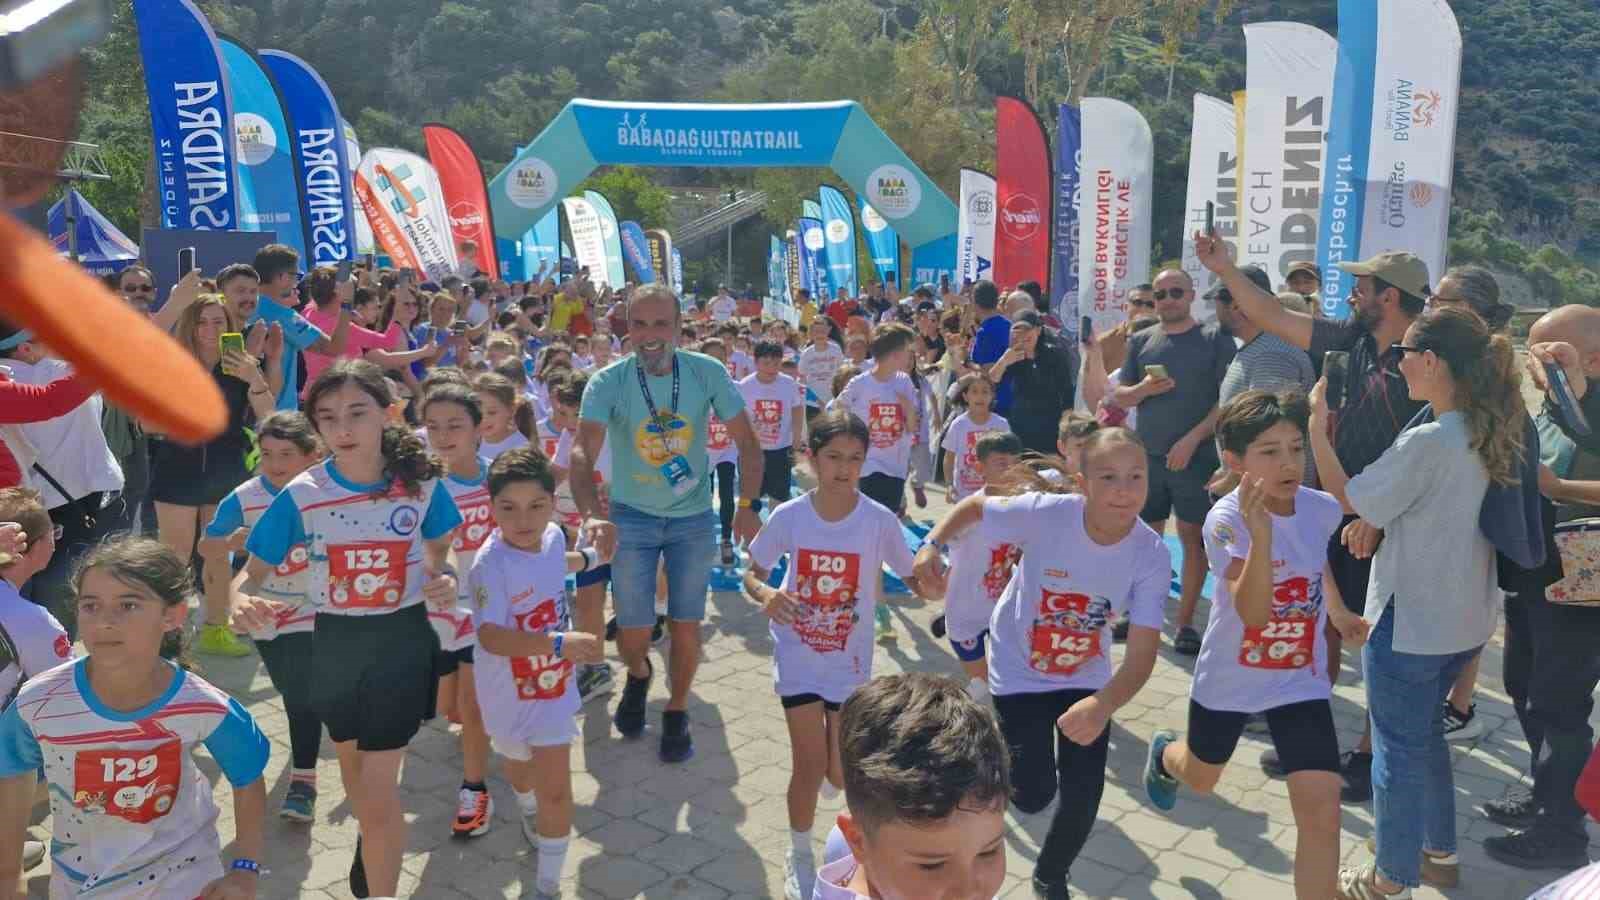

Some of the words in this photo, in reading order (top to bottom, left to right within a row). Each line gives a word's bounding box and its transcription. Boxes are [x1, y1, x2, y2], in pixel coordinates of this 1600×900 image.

[701, 129, 803, 149] ULTRATRAIL
[344, 549, 389, 569] 132
[810, 554, 846, 573] 120
[1261, 622, 1305, 638] 223
[1051, 632, 1091, 650] 142
[100, 754, 158, 784] 129
